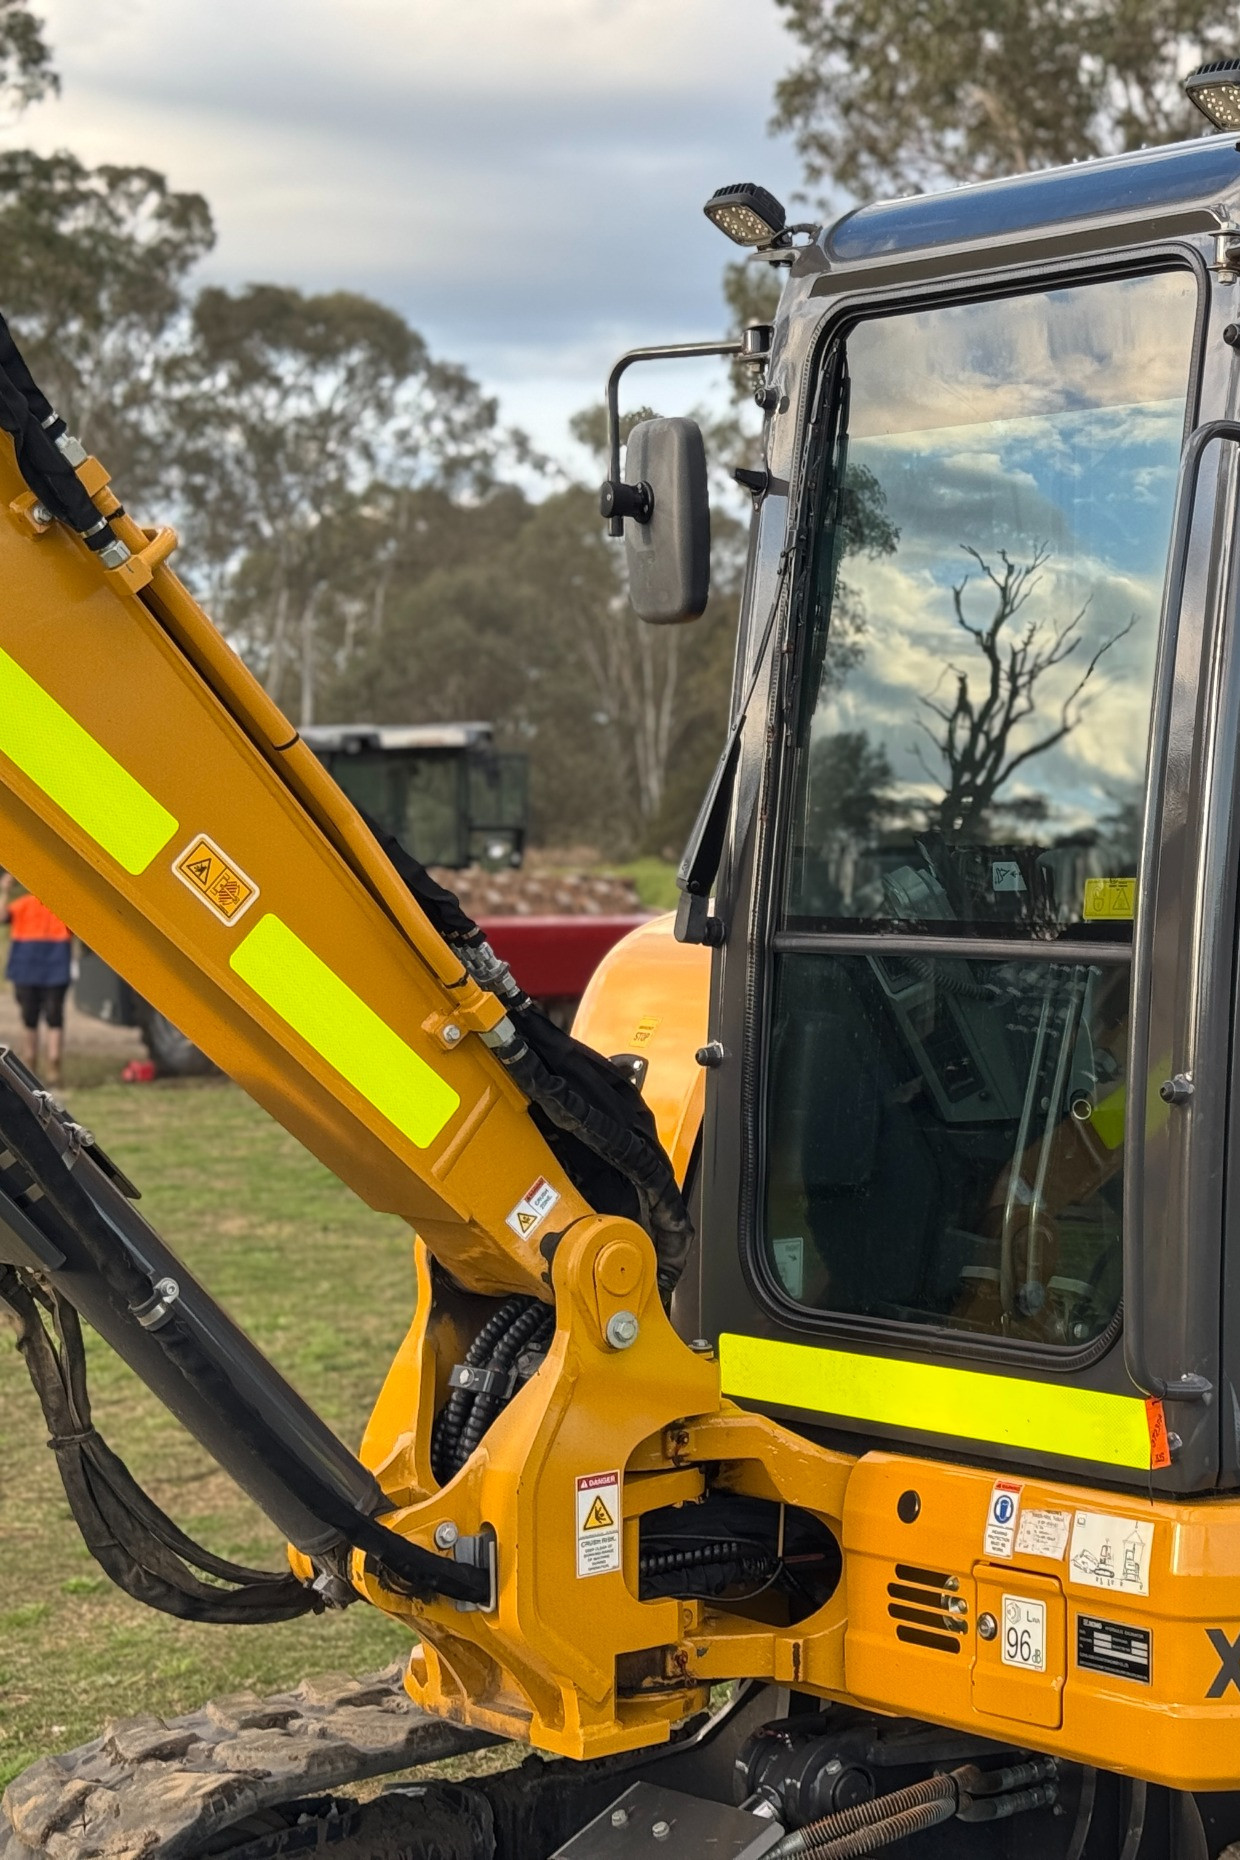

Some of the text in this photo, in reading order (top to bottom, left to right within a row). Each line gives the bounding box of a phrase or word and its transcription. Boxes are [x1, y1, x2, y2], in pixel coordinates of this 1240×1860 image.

[588, 1475, 616, 1487] DANGER
[1007, 1627, 1042, 1664] 96 dB
